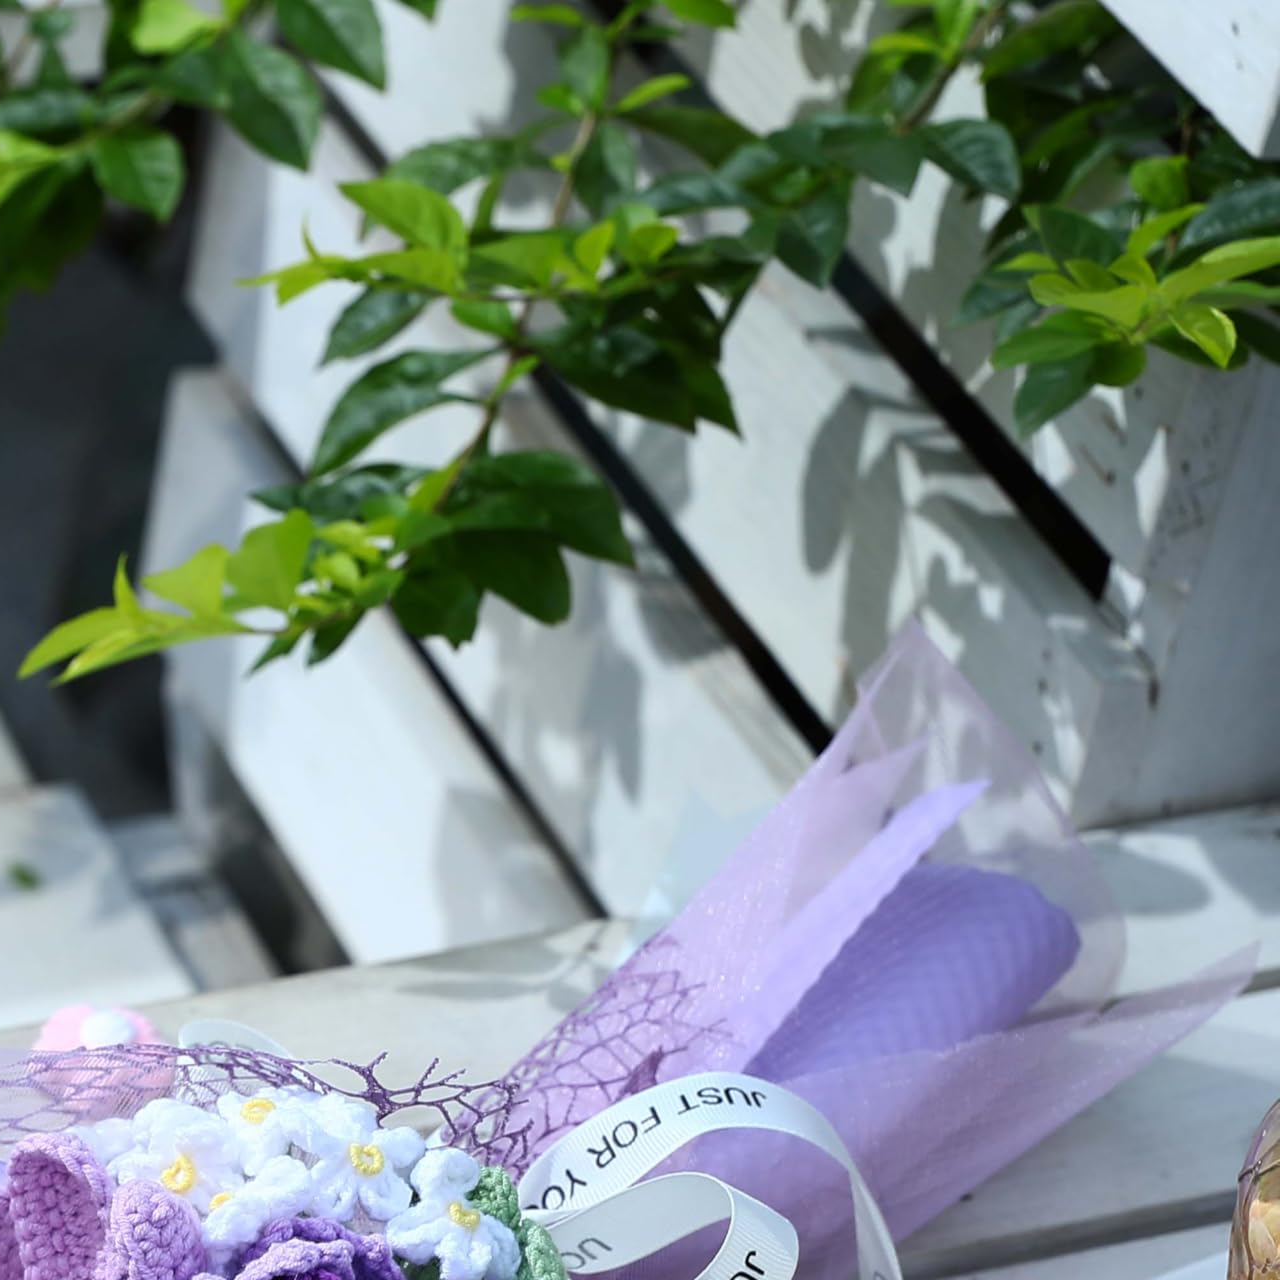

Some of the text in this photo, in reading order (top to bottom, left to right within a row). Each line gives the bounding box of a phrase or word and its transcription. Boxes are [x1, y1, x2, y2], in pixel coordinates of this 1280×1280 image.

[523, 1086, 768, 1211] JUST FOR YO
